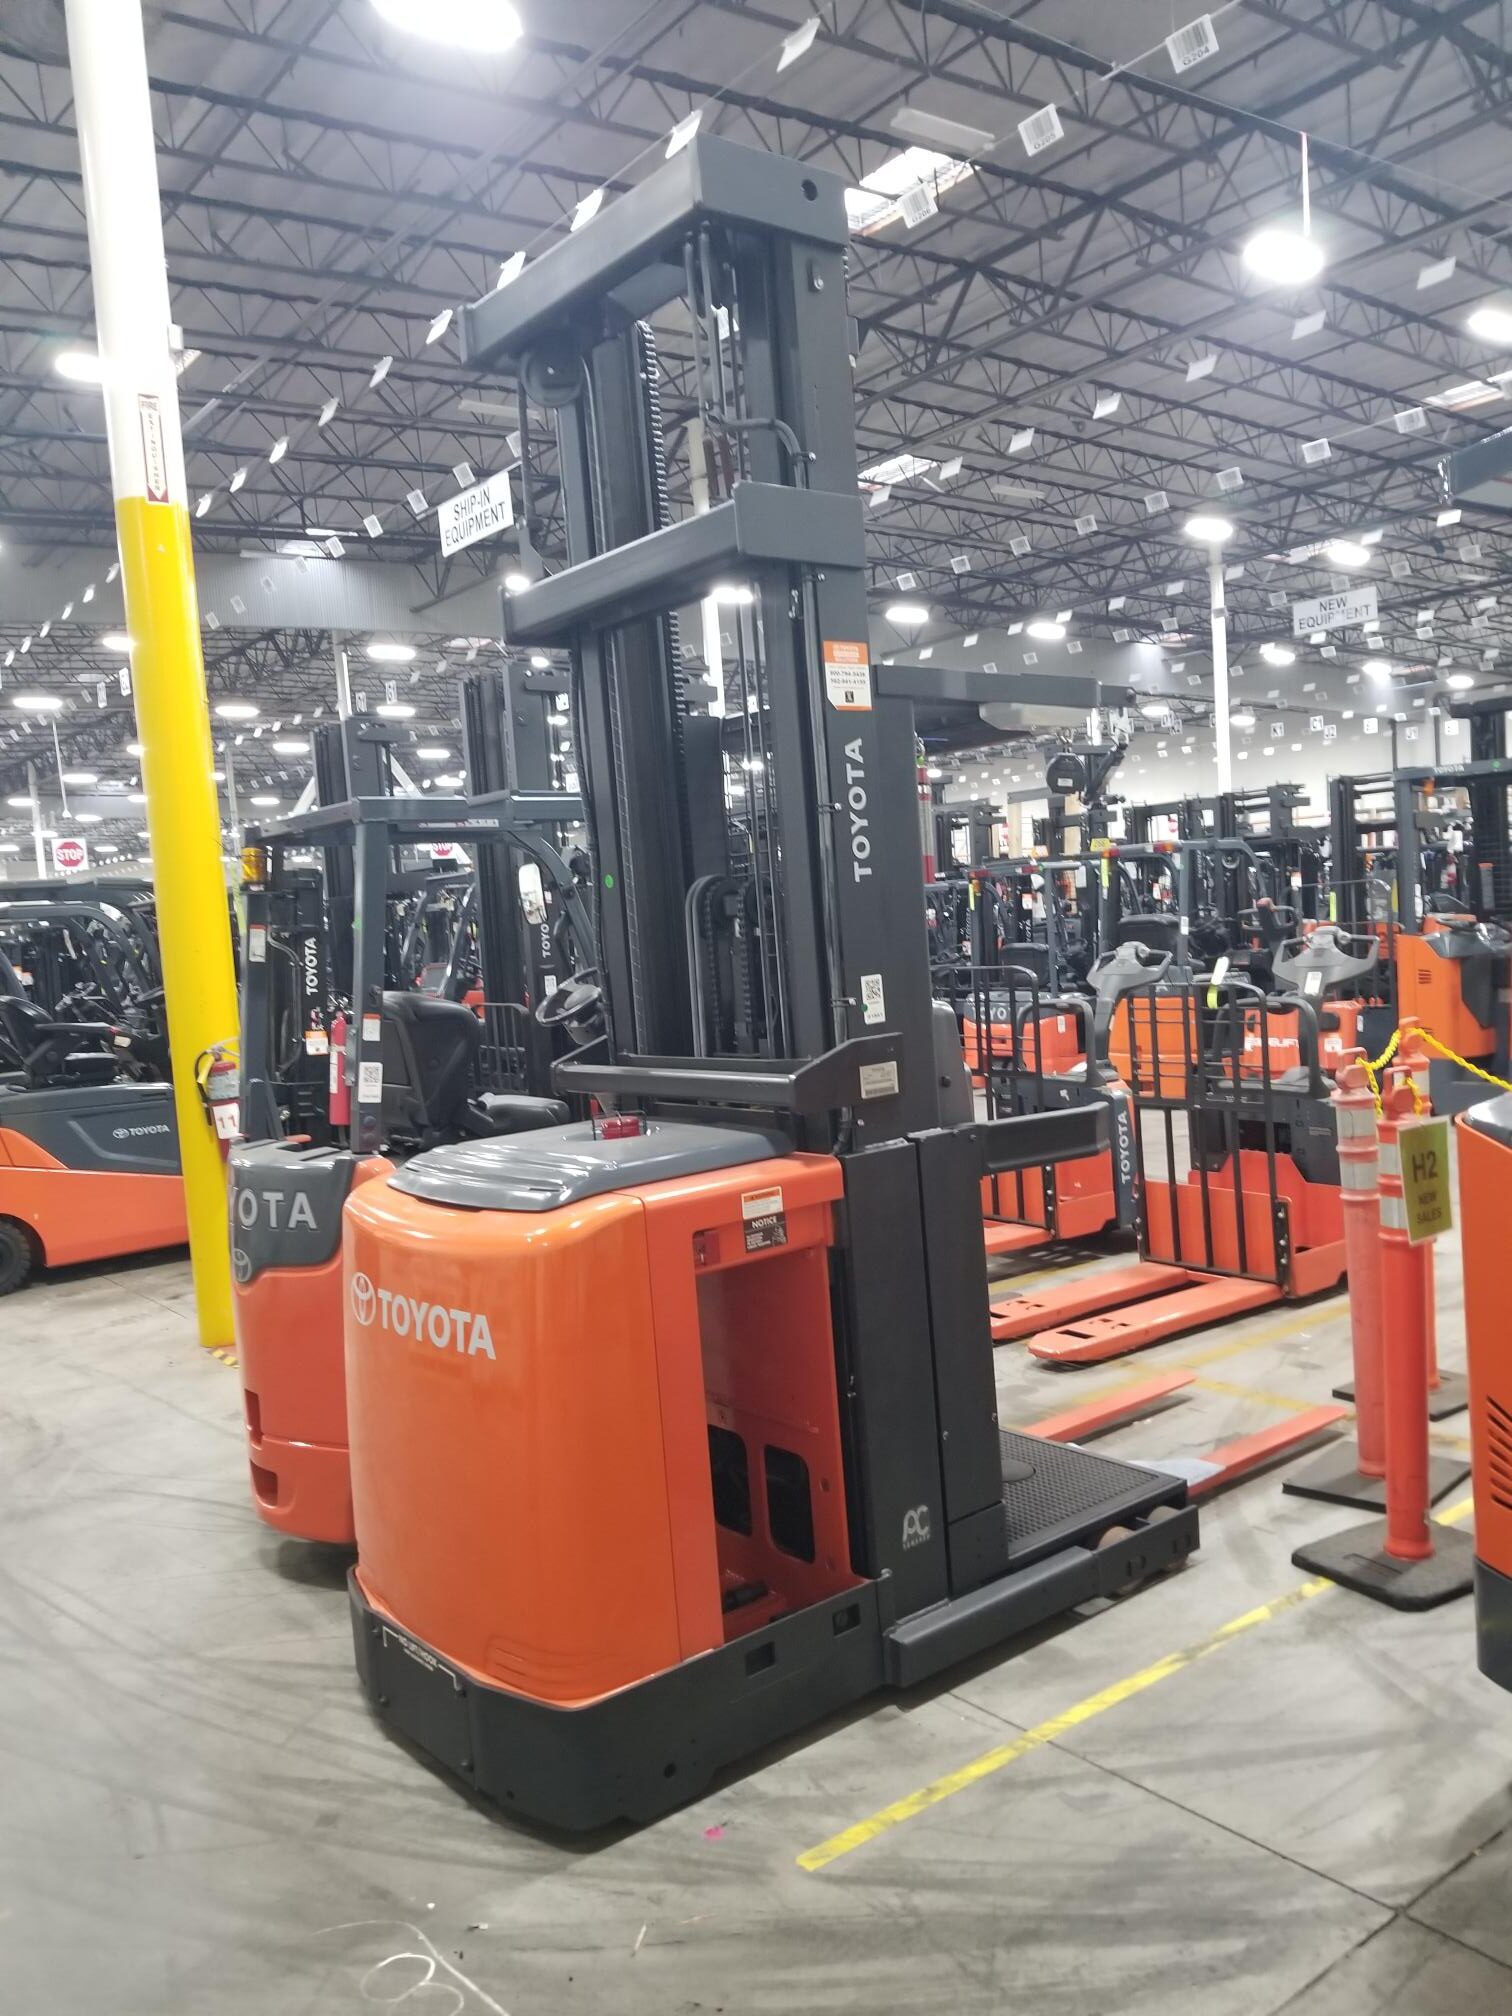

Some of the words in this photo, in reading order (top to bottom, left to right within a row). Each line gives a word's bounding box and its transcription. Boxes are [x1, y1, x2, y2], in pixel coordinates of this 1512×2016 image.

[453, 486, 491, 521] SHIP-IN
[444, 501, 505, 547] EQUIPMENT
[1299, 604, 1371, 630] EQUIPENT
[1319, 594, 1348, 612] NEW
[844, 738, 872, 882] TOYOTA
[57, 848, 83, 861] STOP
[540, 923, 551, 959] TOYO
[303, 936, 319, 996] TOYOTA
[129, 1124, 170, 1136] TOYOTA
[1118, 1110, 1132, 1185] TOYOTA
[1411, 1150, 1438, 1183] H2
[751, 1215, 777, 1229] NOTICE
[1416, 1207, 1442, 1225] SALES
[377, 1288, 497, 1361] TOYOTA
